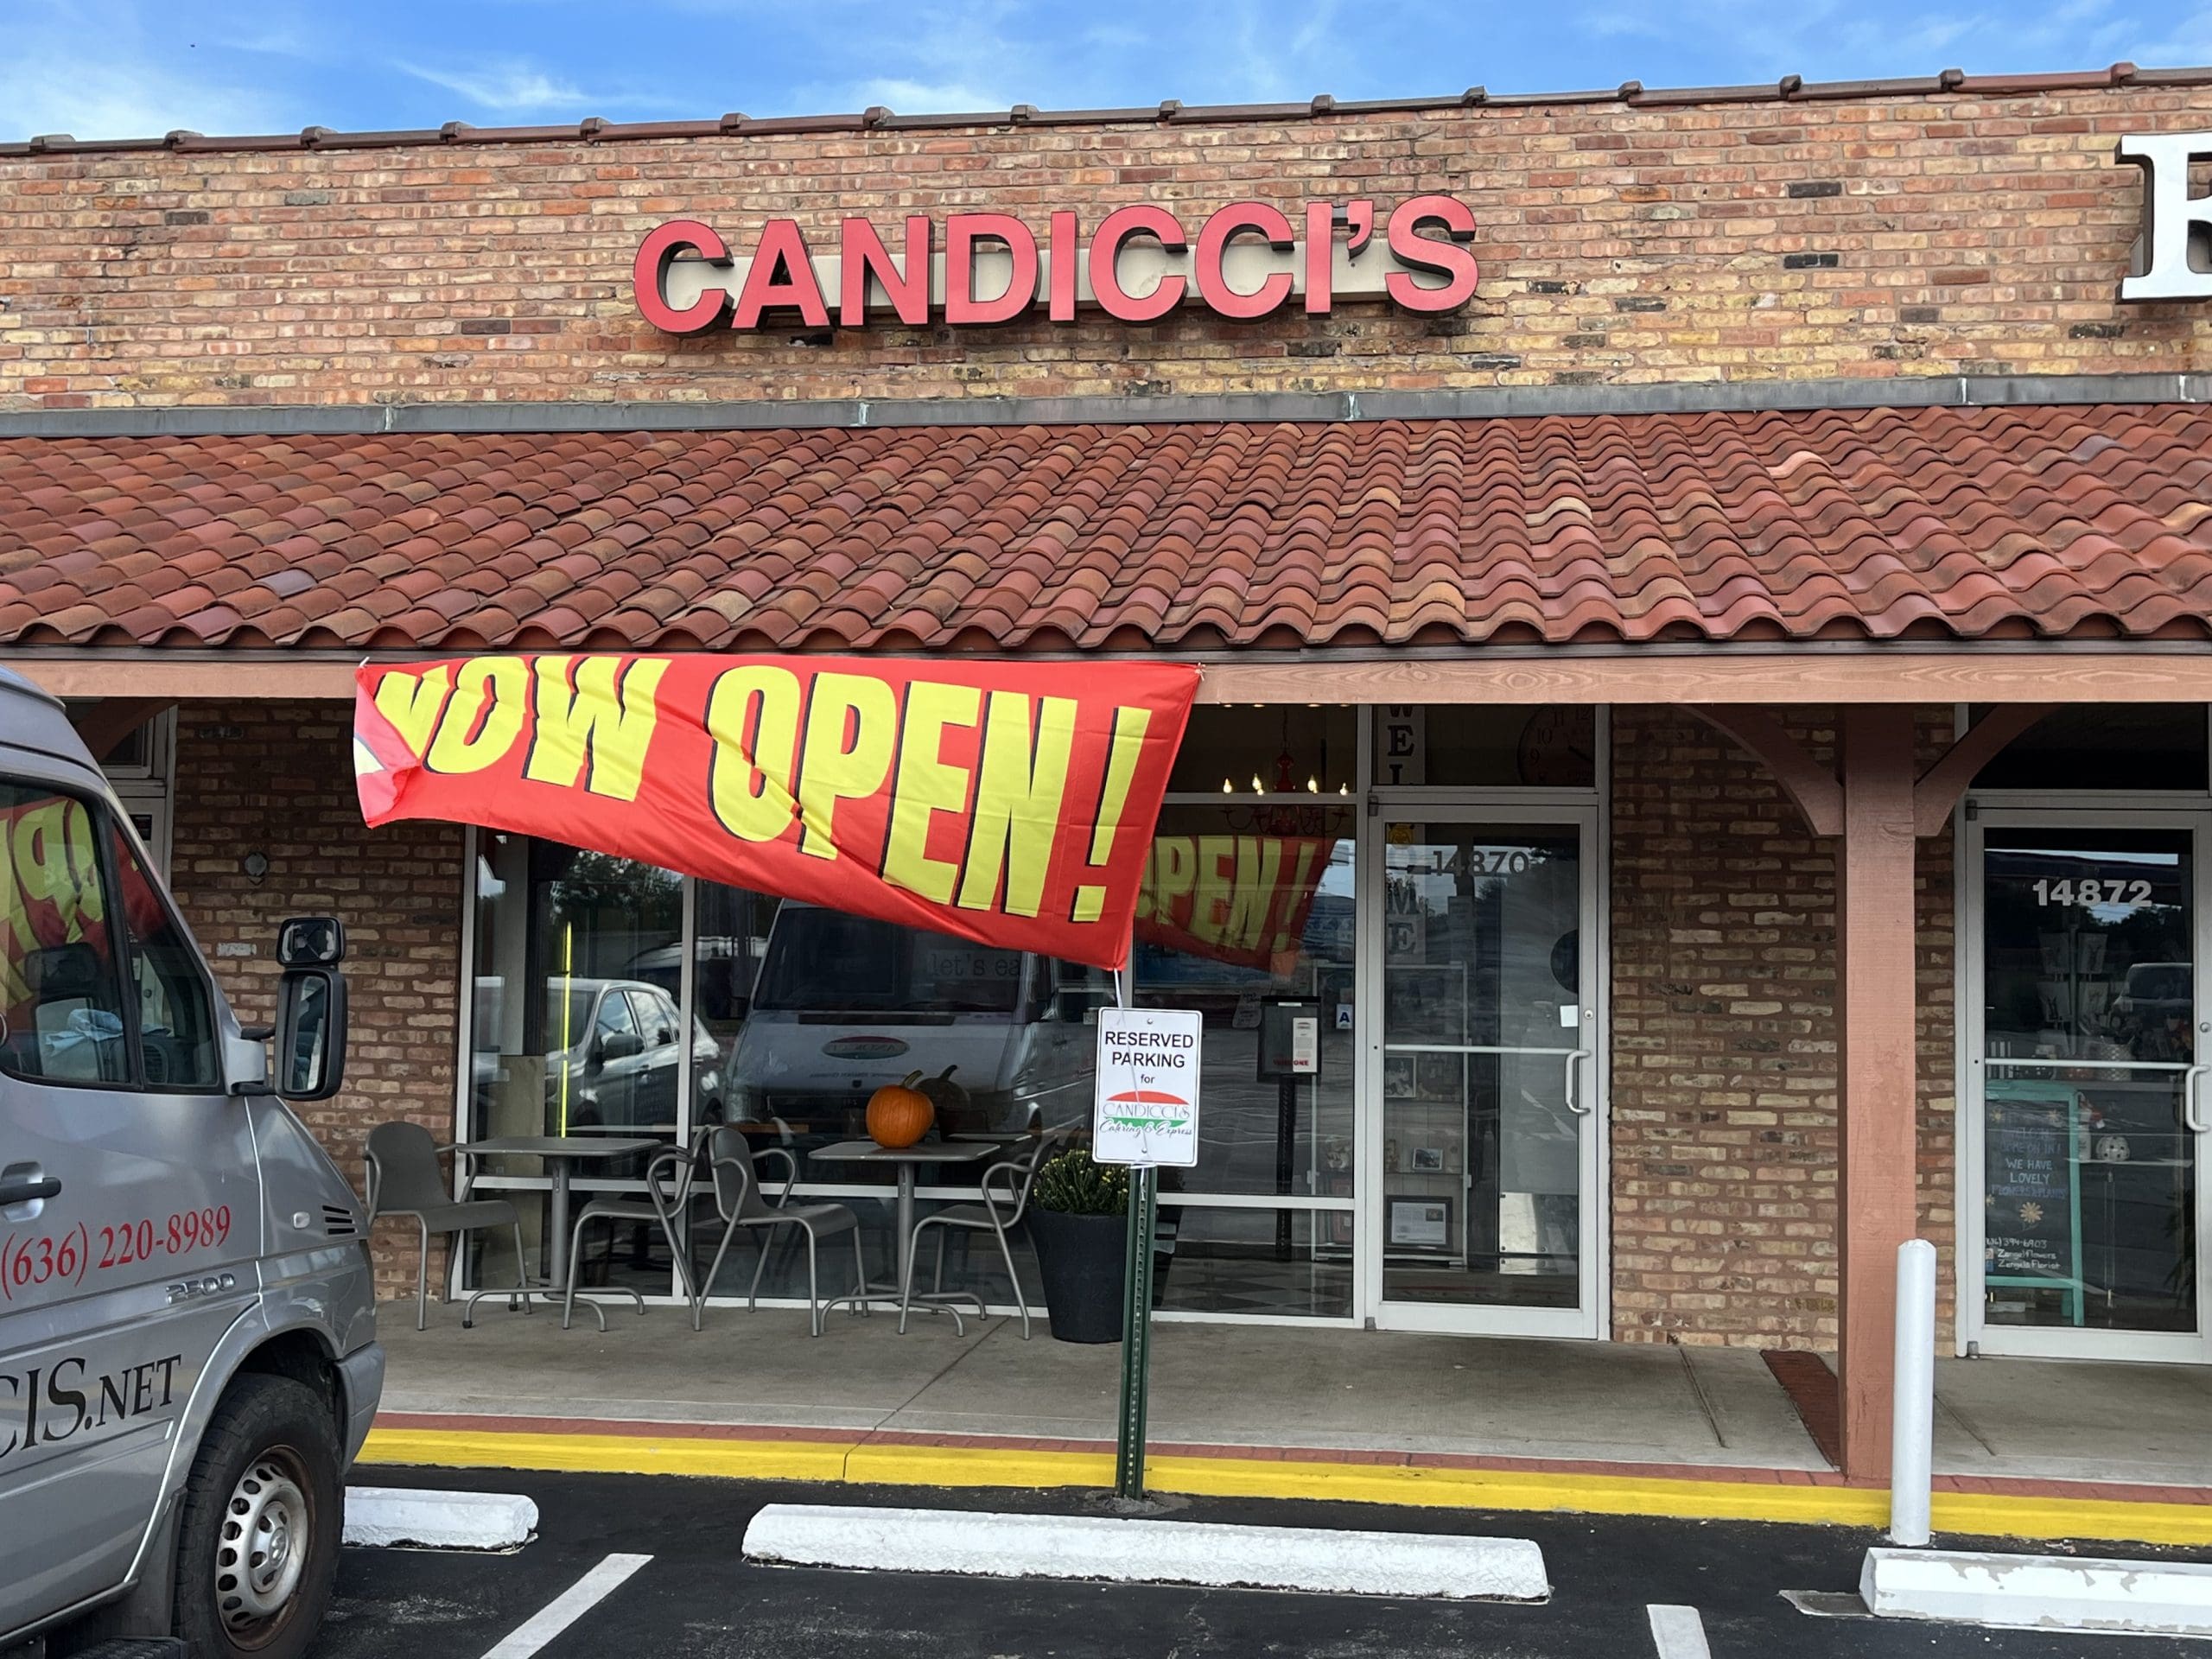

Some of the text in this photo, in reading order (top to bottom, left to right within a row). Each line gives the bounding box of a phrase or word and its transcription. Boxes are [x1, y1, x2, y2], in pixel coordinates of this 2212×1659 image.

[632, 195, 1479, 335] CANDICCI'S
[1432, 849, 1530, 877] 14870
[2032, 879, 2153, 907] 14872
[1338, 1012, 1351, 1023] A
[1104, 1031, 1194, 1048] RESERVED
[1111, 1052, 1185, 1068] PARKING
[1141, 1074, 1155, 1084] for
[1103, 1102, 1191, 1120] CANDICCI'S
[2005, 1158, 2053, 1170] WE HAVE
[2010, 1172, 2050, 1185] LOVELY
[1, 1205, 232, 1301] (636) 220-8989
